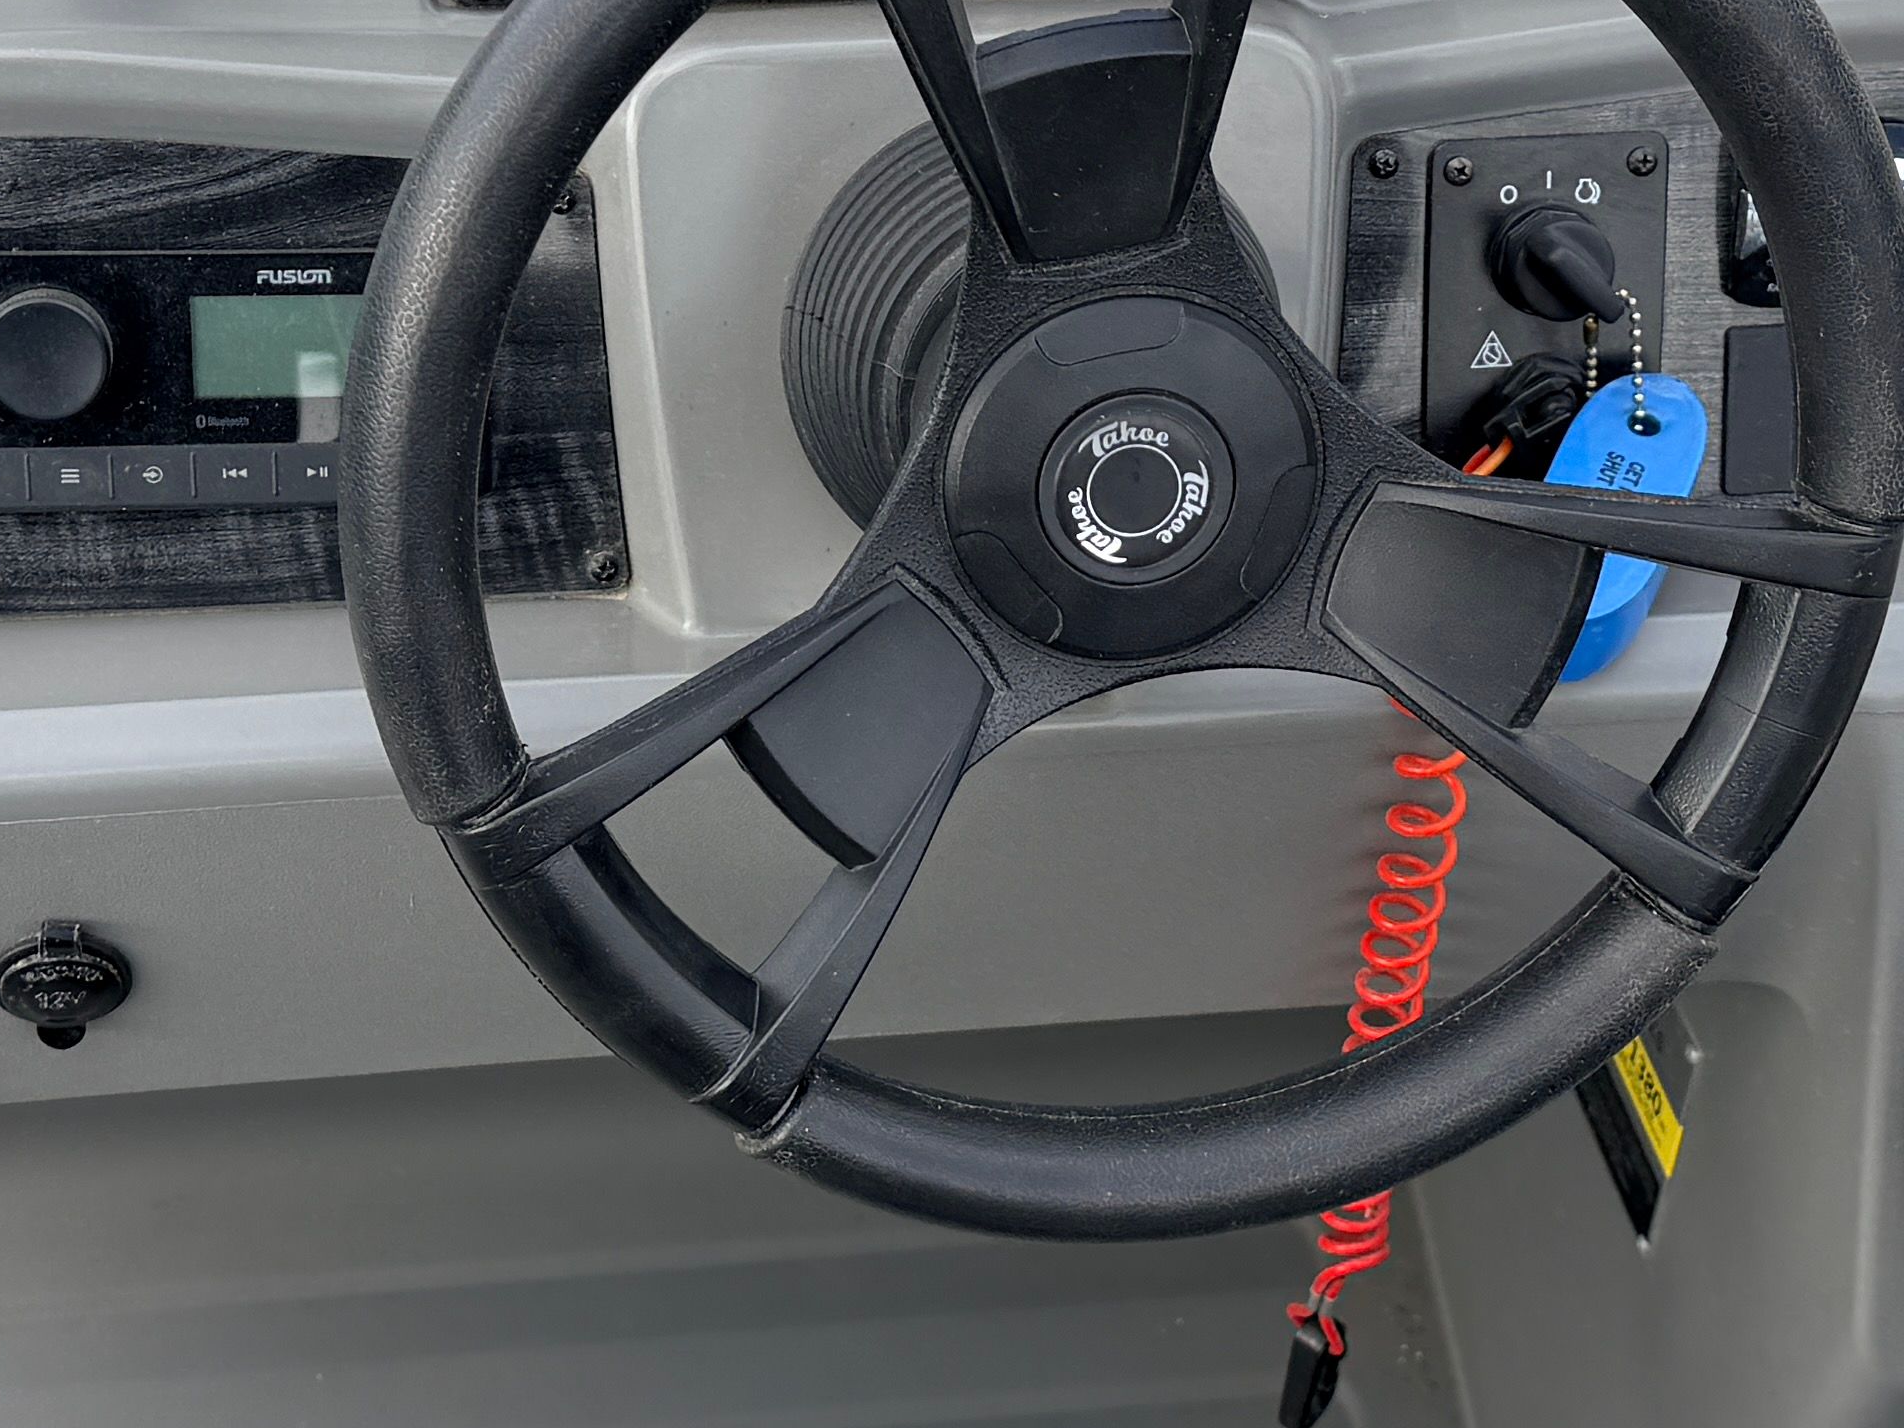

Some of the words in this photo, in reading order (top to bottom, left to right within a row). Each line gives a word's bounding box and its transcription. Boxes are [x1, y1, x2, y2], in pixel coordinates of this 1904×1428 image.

[256, 269, 332, 284] FUSION
[1078, 421, 1169, 458] Tahoe
[1067, 487, 1128, 564] Tahoe
[1156, 460, 1209, 544] Tahoe
